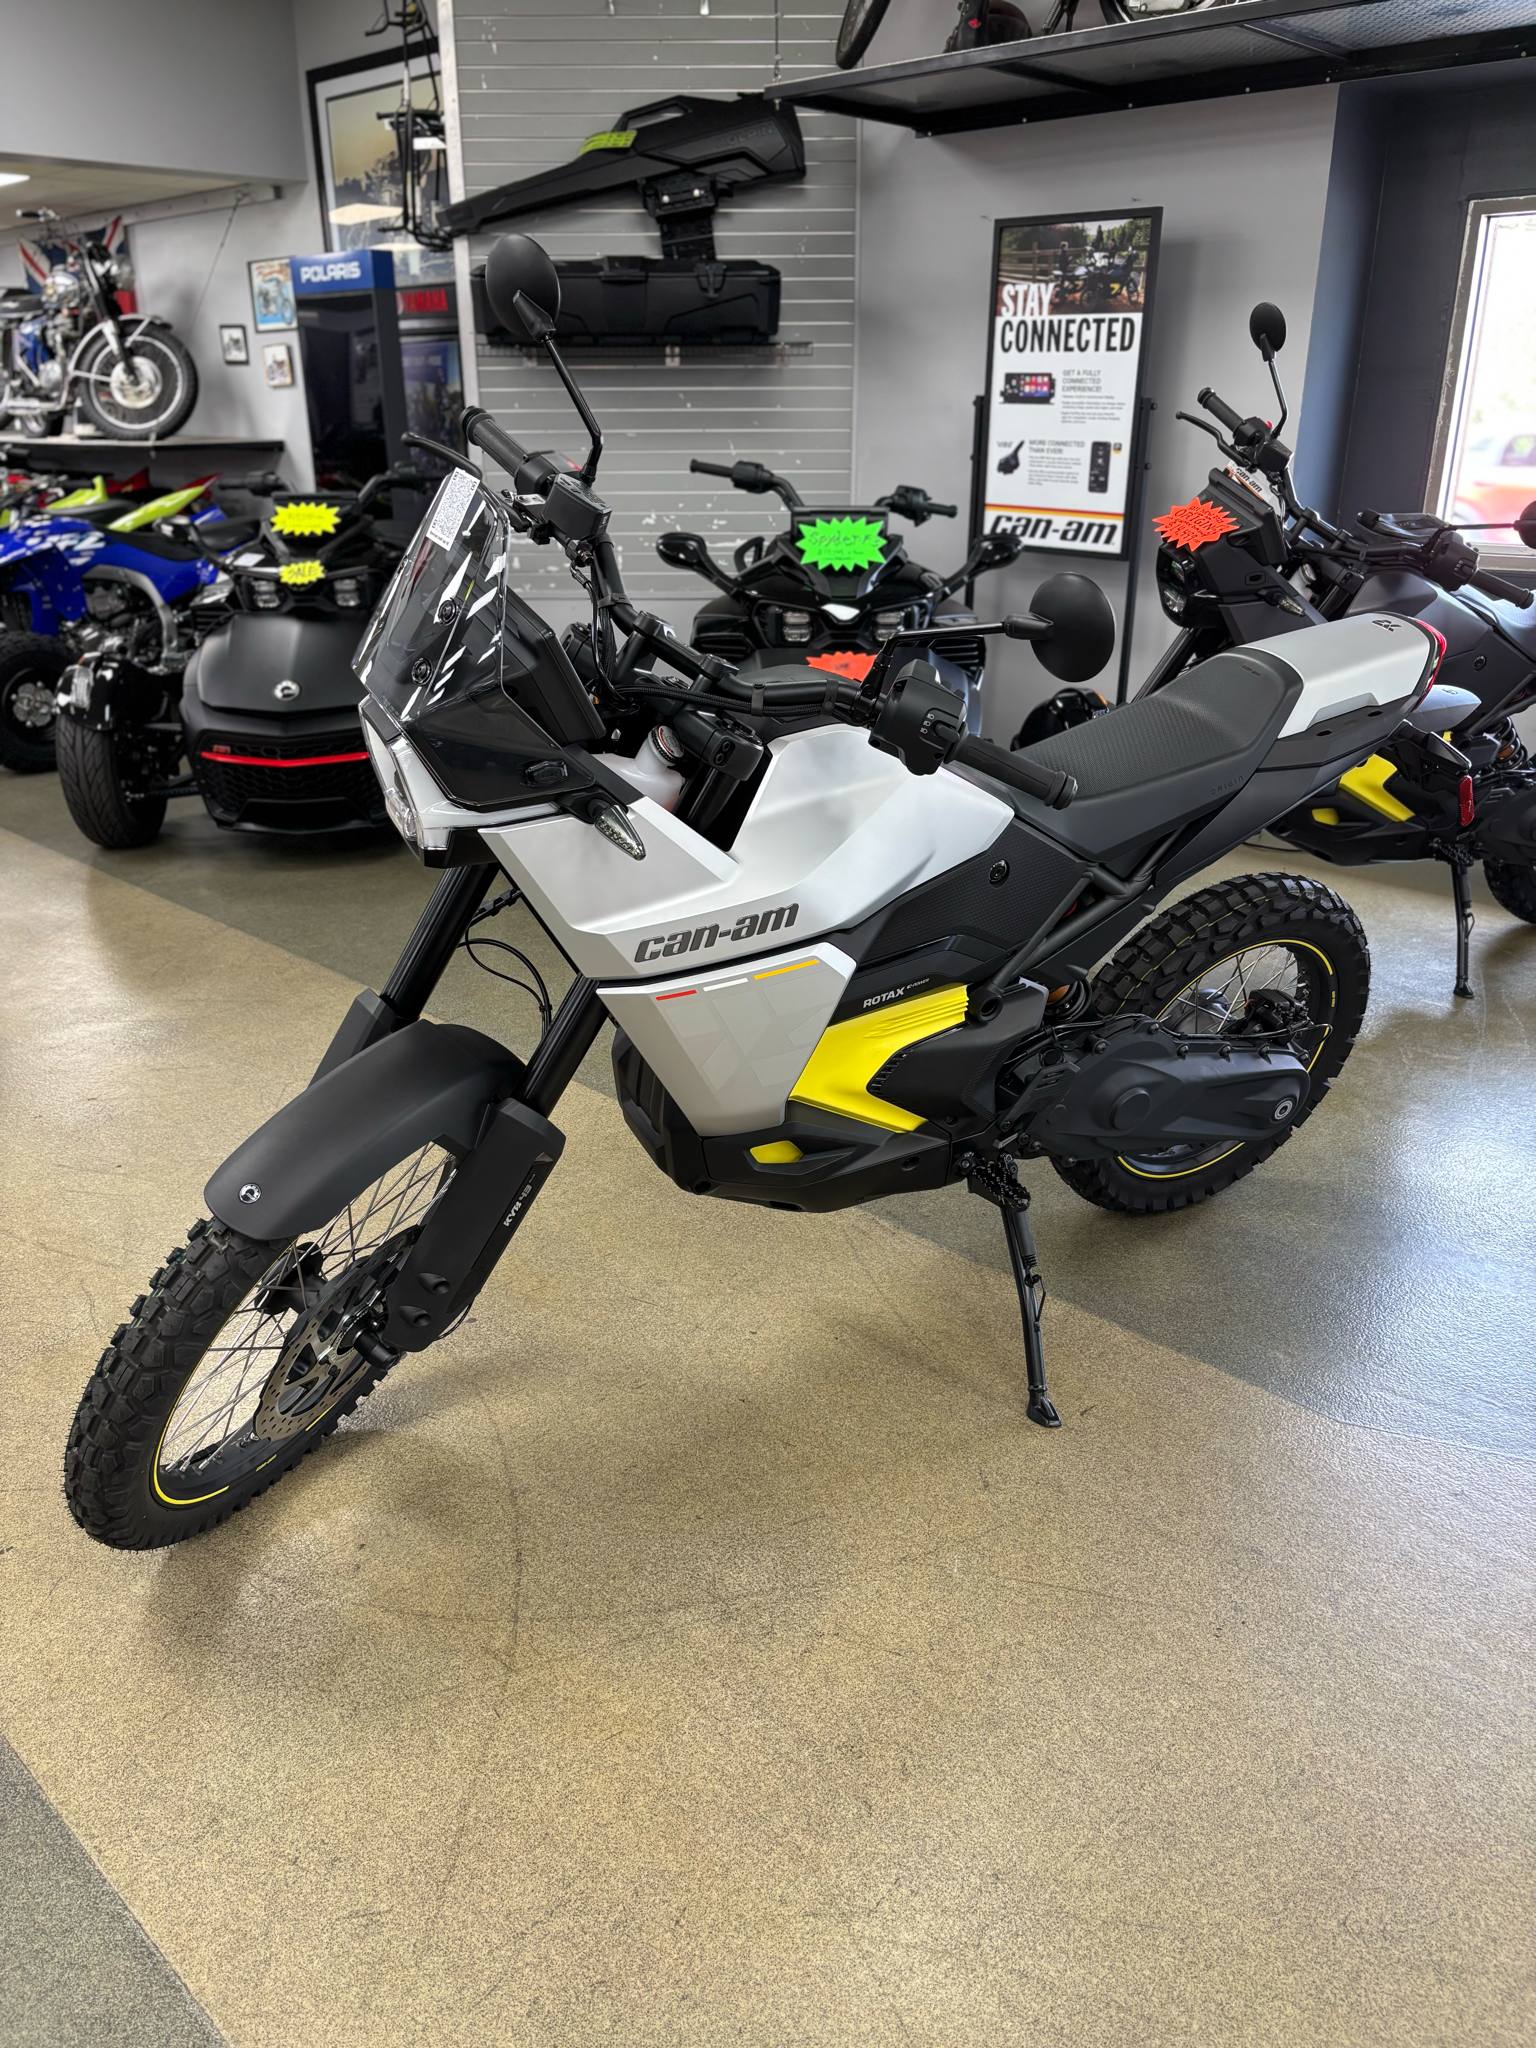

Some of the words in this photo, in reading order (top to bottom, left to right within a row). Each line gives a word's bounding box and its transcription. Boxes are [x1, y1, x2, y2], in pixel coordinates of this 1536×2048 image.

[301, 261, 362, 284] POLARIS
[1001, 282, 1055, 317] STAY
[1001, 317, 1136, 353] CONNECTED
[989, 514, 1118, 545] can-am
[634, 903, 799, 963] can-am
[862, 986, 905, 1009] ROTAX
